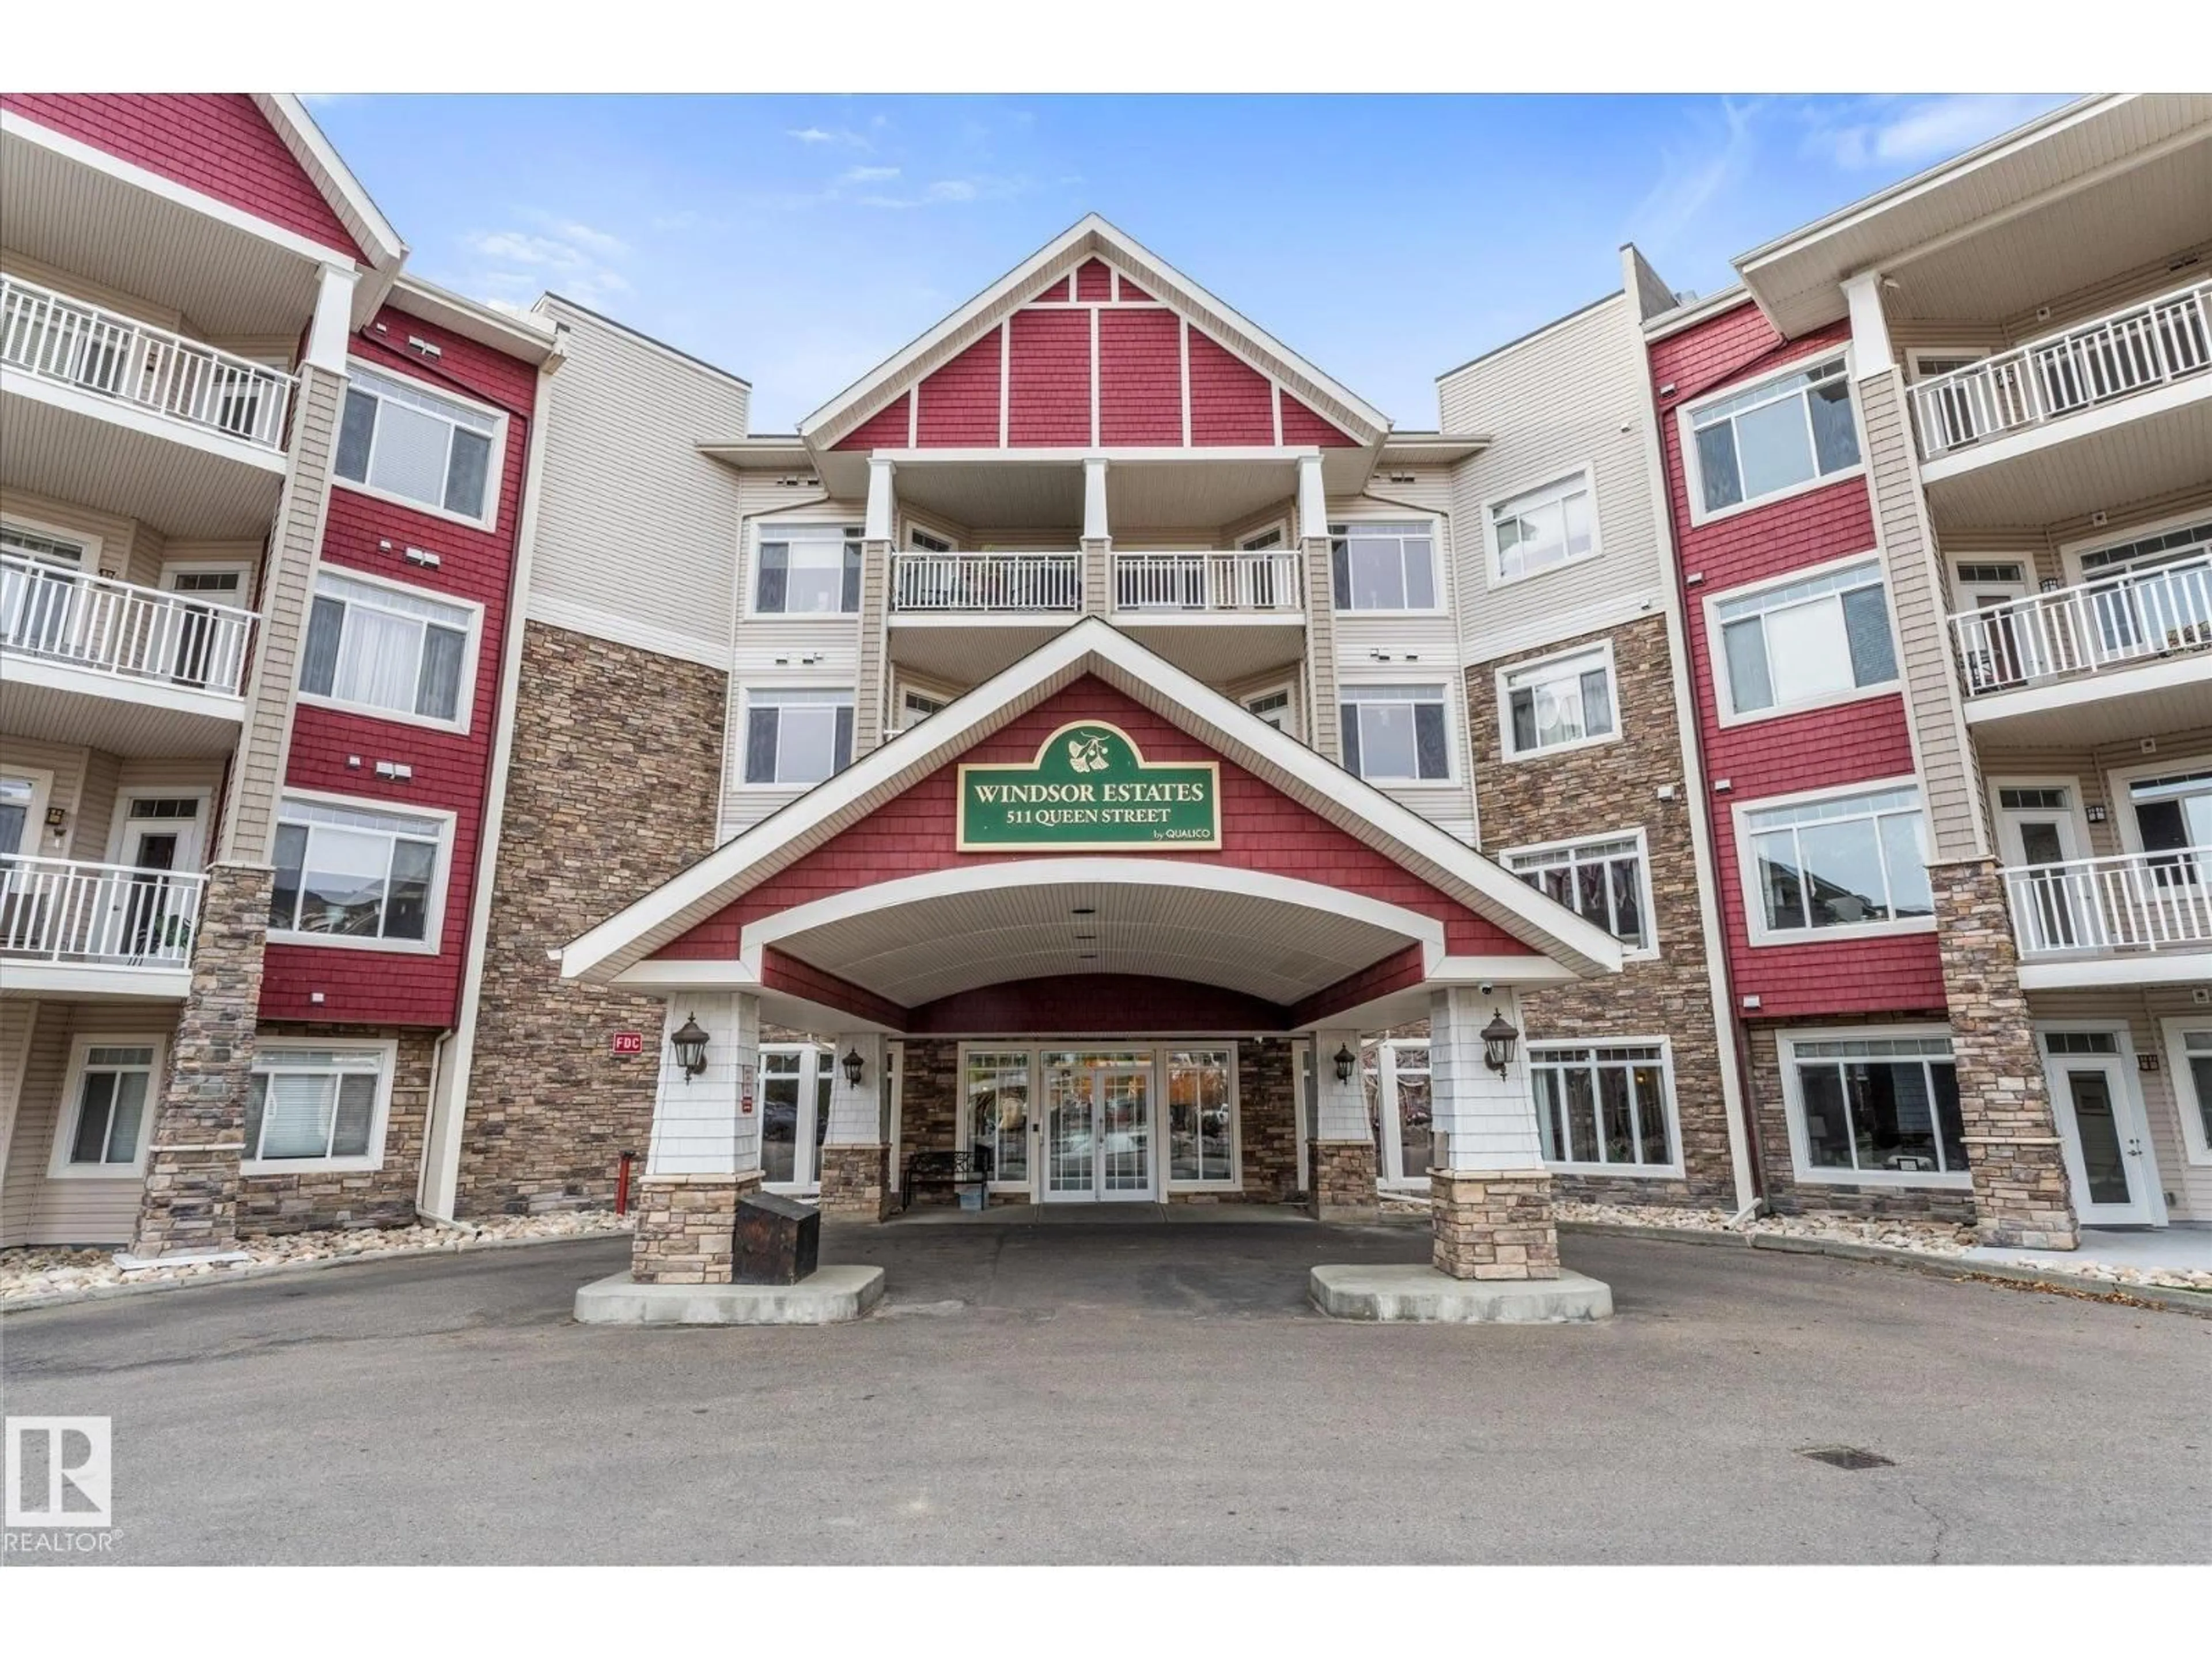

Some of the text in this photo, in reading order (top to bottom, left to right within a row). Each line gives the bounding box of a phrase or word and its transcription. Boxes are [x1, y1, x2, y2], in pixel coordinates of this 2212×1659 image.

[974, 783, 1204, 803] WINDSOR ESTATES
[1006, 809, 1171, 827] 511 QUEEN STREET
[1153, 829, 1210, 840] by QUALICO
[616, 1037, 639, 1048] FDC
